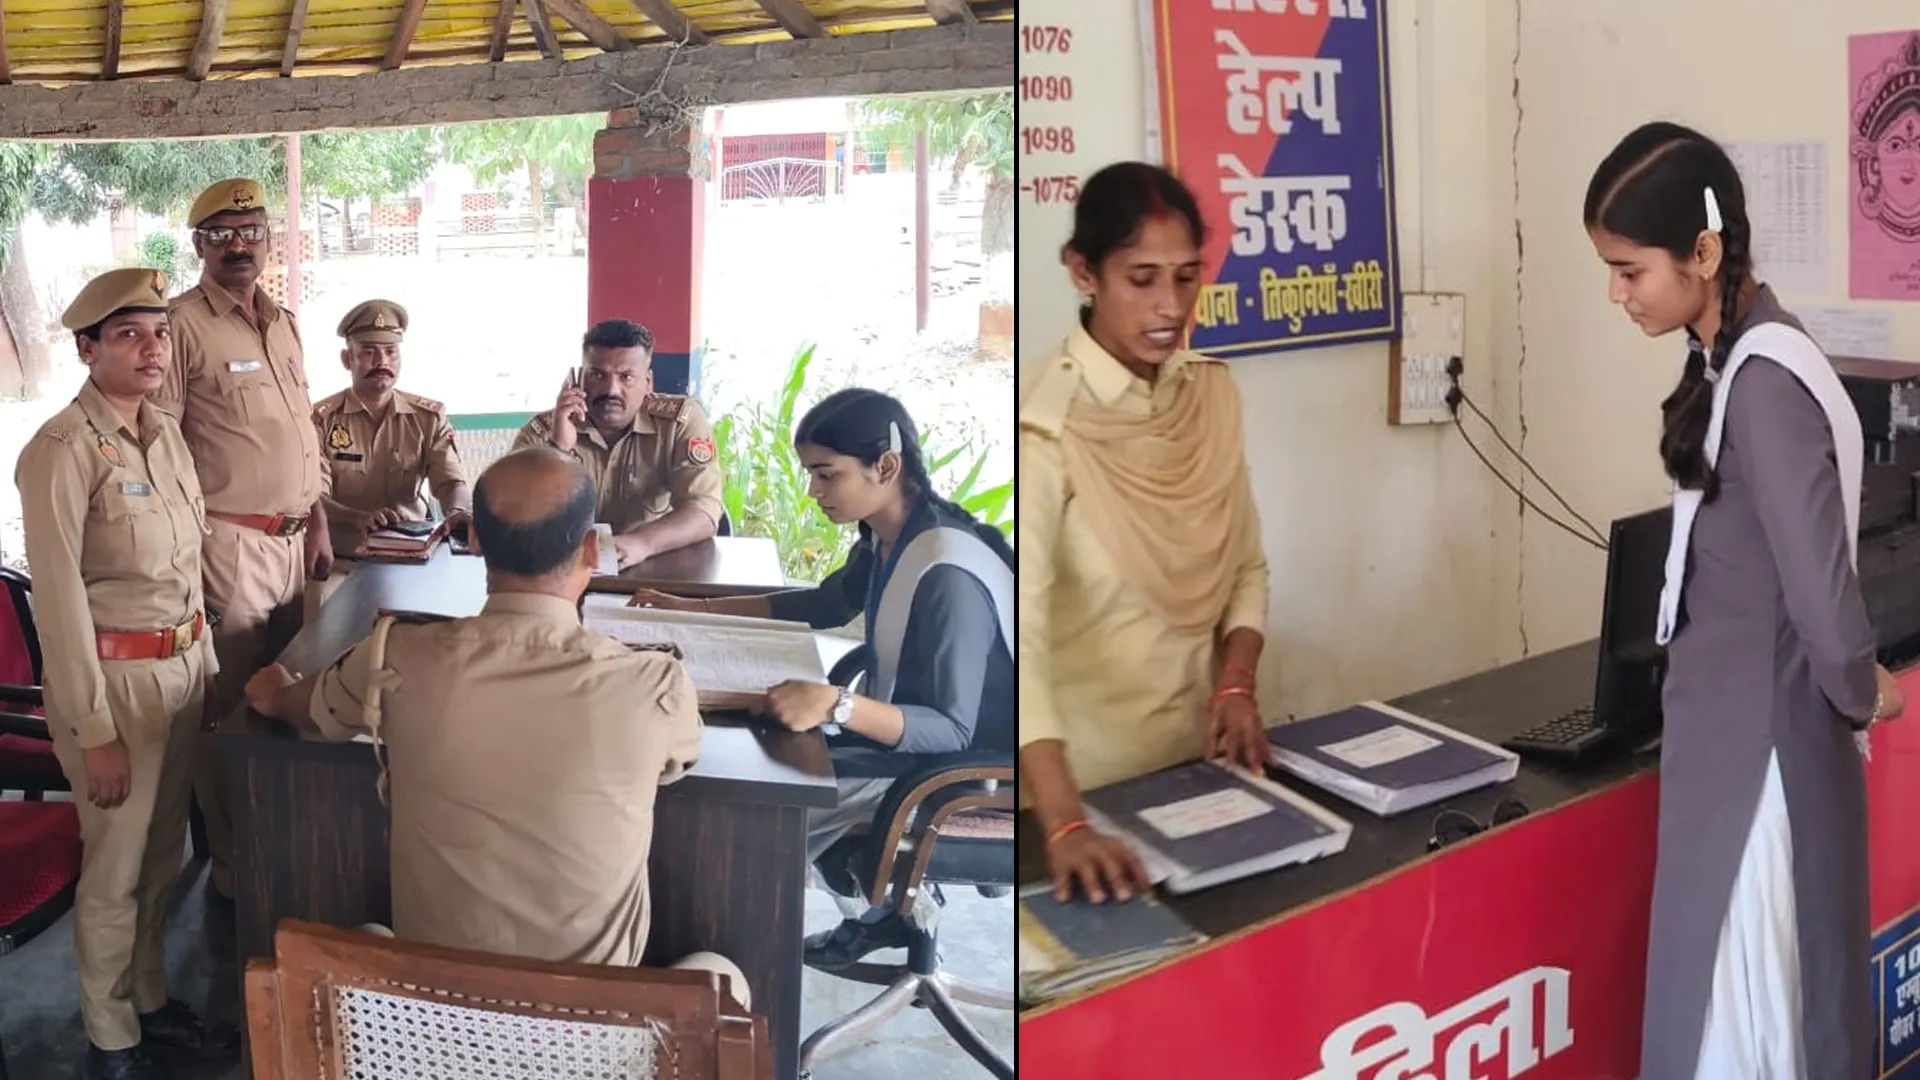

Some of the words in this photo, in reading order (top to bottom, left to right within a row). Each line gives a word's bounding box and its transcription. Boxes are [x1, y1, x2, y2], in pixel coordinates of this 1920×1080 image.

[1021, 25, 1073, 54] 1076
[1020, 75, 1073, 101] 1090
[1215, 29, 1342, 135] हेल्प
[1021, 126, 1076, 155] 1098
[1217, 154, 1351, 257] डेस्क
